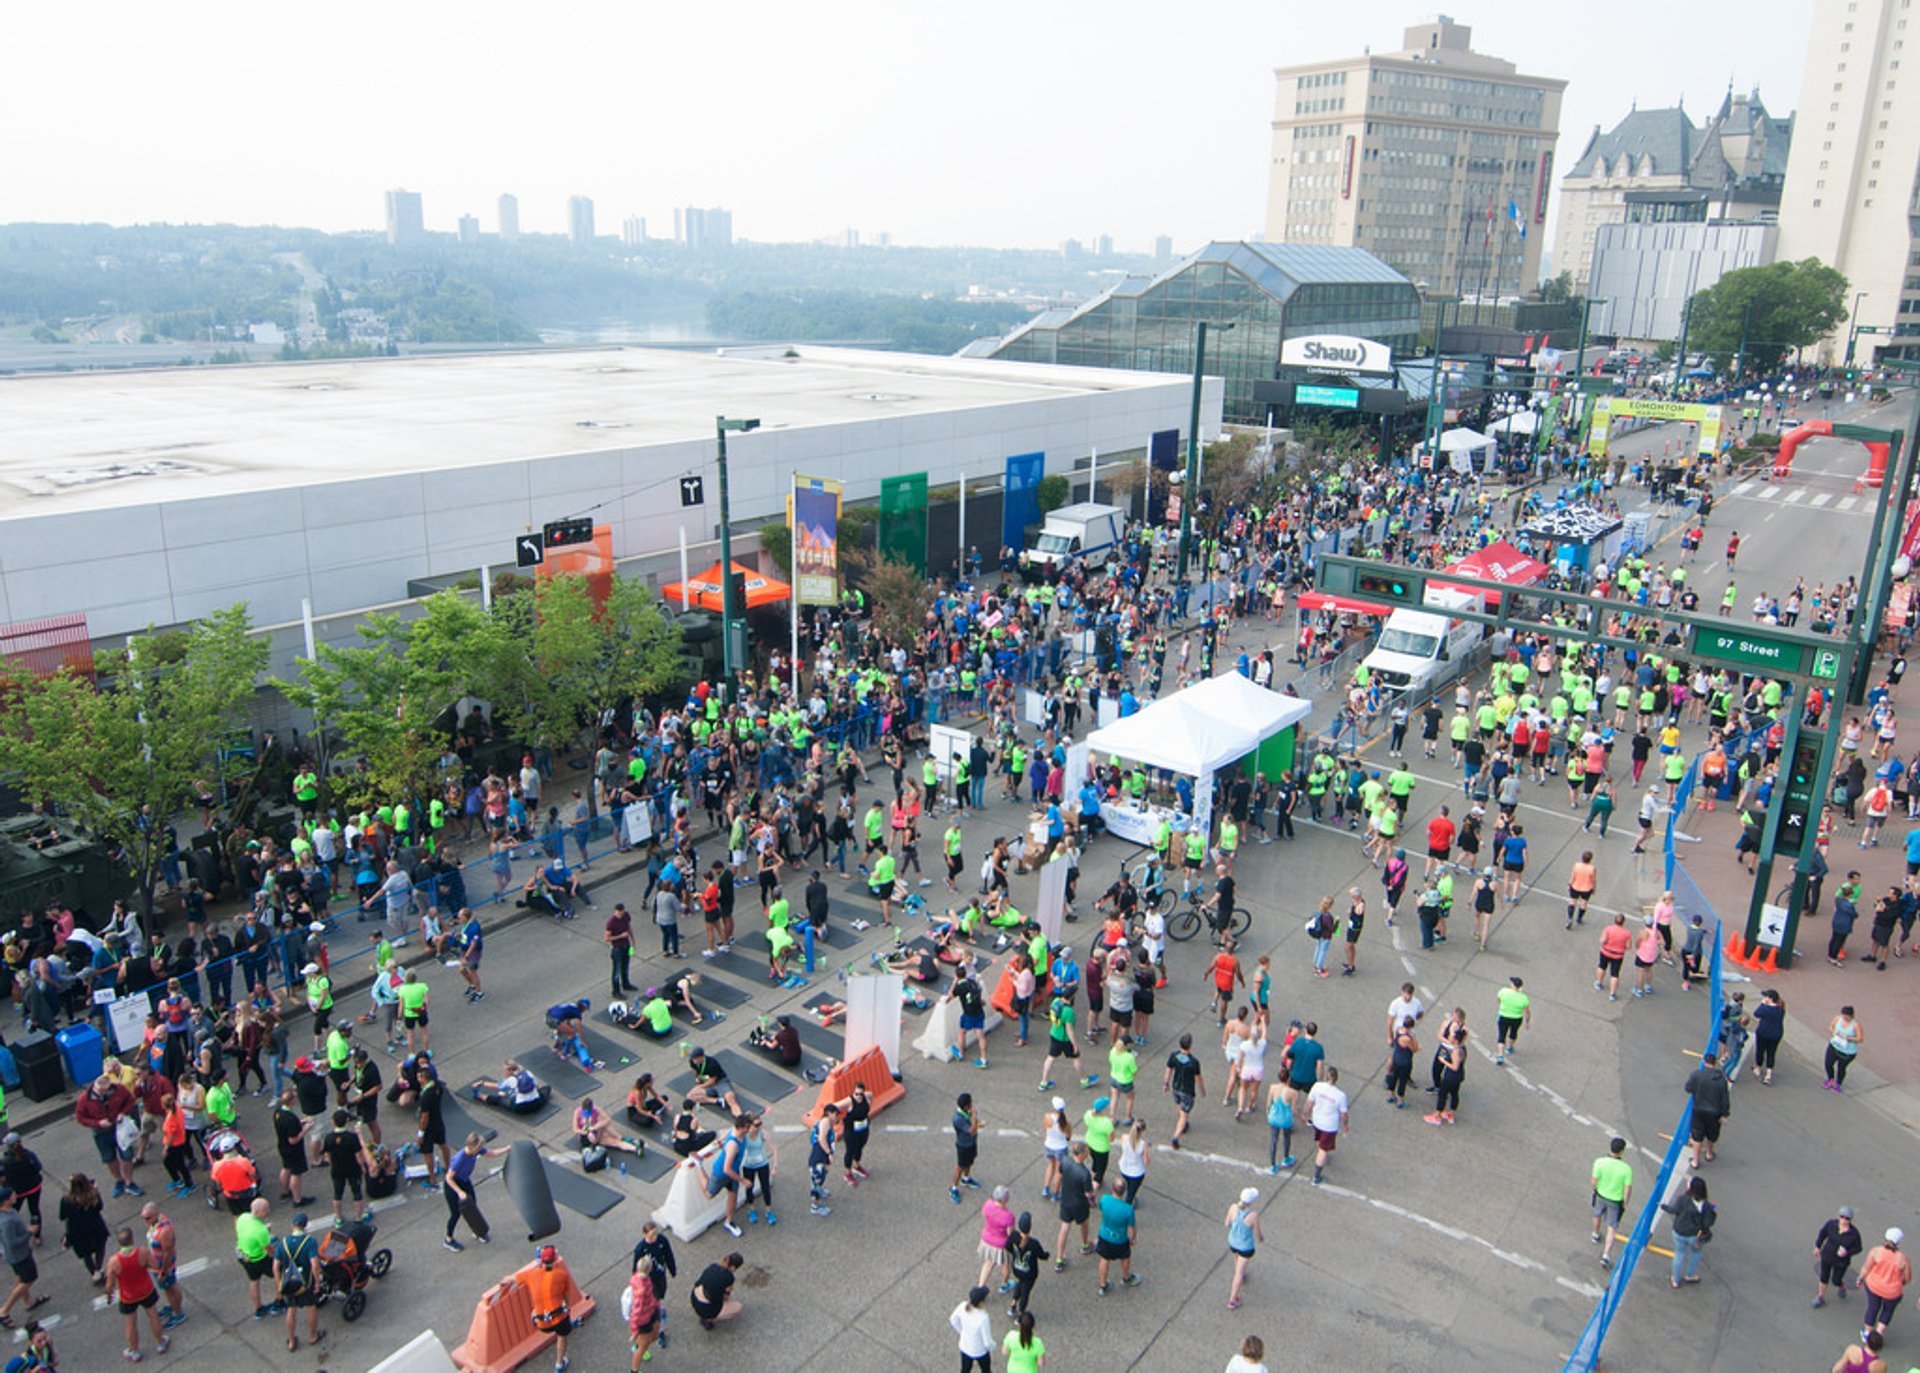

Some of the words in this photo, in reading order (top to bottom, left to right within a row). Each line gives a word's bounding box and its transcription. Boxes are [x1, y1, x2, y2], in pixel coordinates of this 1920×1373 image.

[1629, 401, 1685, 412] EDMONTON
[1717, 637, 1734, 649] 97
[1739, 641, 1780, 658] Street
